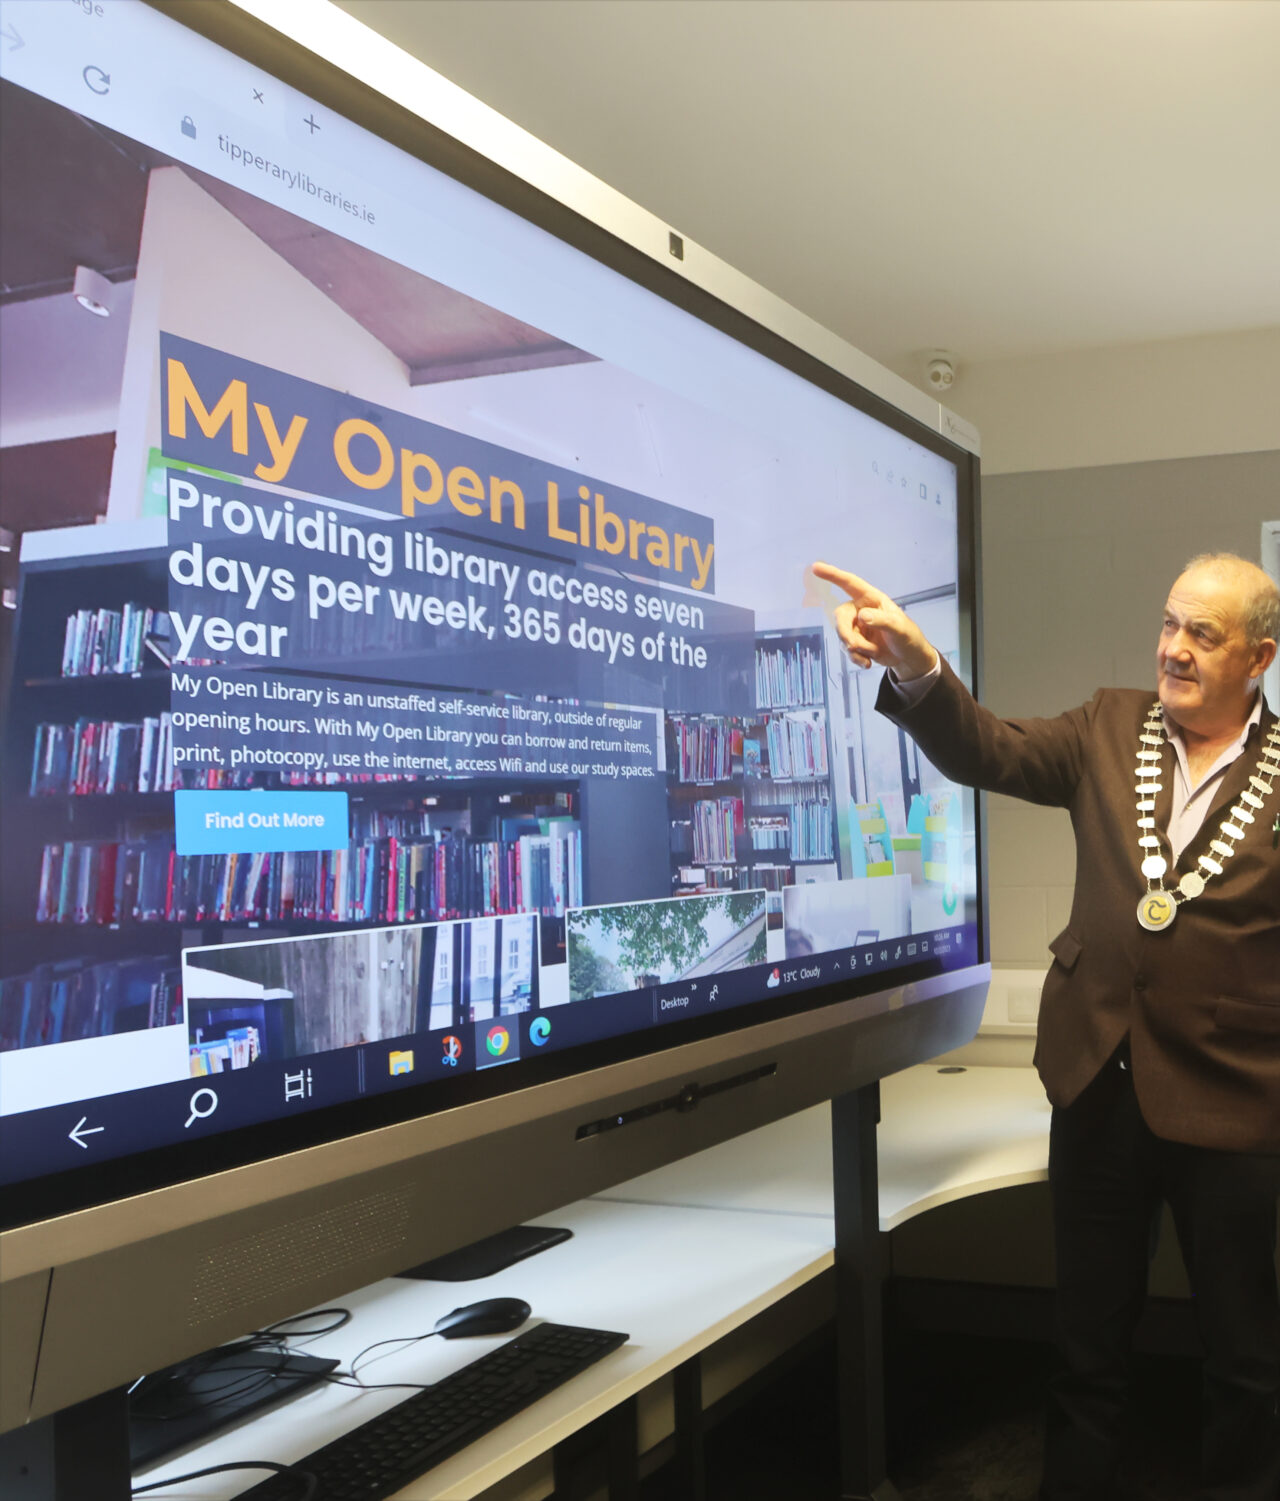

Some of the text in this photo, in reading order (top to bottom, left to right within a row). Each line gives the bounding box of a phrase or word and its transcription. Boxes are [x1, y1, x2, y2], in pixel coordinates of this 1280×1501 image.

[218, 133, 376, 225] tipperarylibraries.ie
[167, 357, 715, 590] My Open Library
[168, 478, 704, 630] Providing library access seven
[169, 543, 708, 669] days per week, 365 days of the
[169, 610, 288, 662] year
[171, 672, 642, 732] My Open Library is an unstaffed self-service library, outside of regular
[172, 710, 652, 756] opening hours. With My Open Library you can borrow and return items,
[173, 744, 655, 779] print, photocopy, use the internet, access Wifi and use our study spaces.
[205, 812, 325, 829] Find Out More
[800, 965, 820, 979] Cloudy
[661, 996, 689, 1010] Desktop
